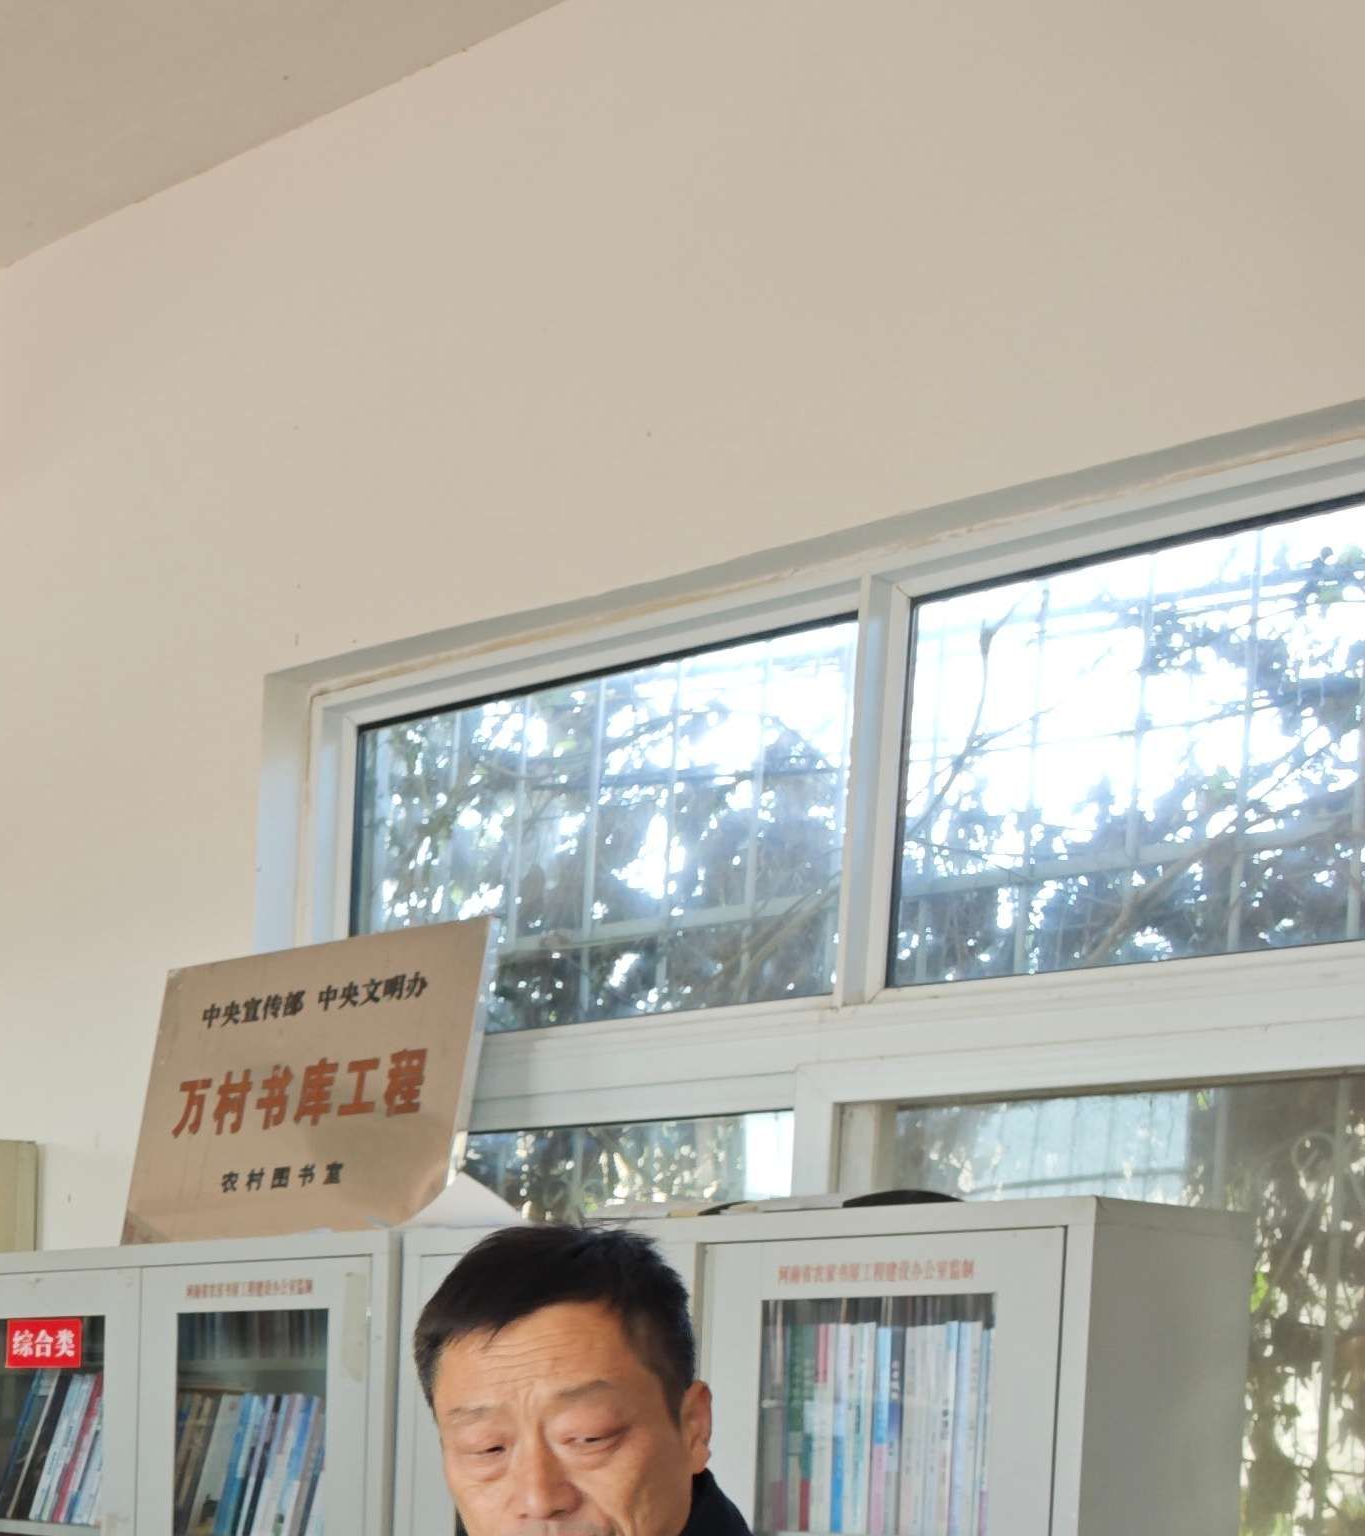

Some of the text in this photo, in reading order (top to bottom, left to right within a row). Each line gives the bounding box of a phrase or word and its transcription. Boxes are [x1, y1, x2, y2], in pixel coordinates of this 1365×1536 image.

[201, 971, 429, 1030] 中央宣传部 中央文明办
[171, 1047, 429, 1138] 万村书库工程
[220, 1160, 345, 1194] 农村图书室
[11, 1328, 76, 1358] 综合类
